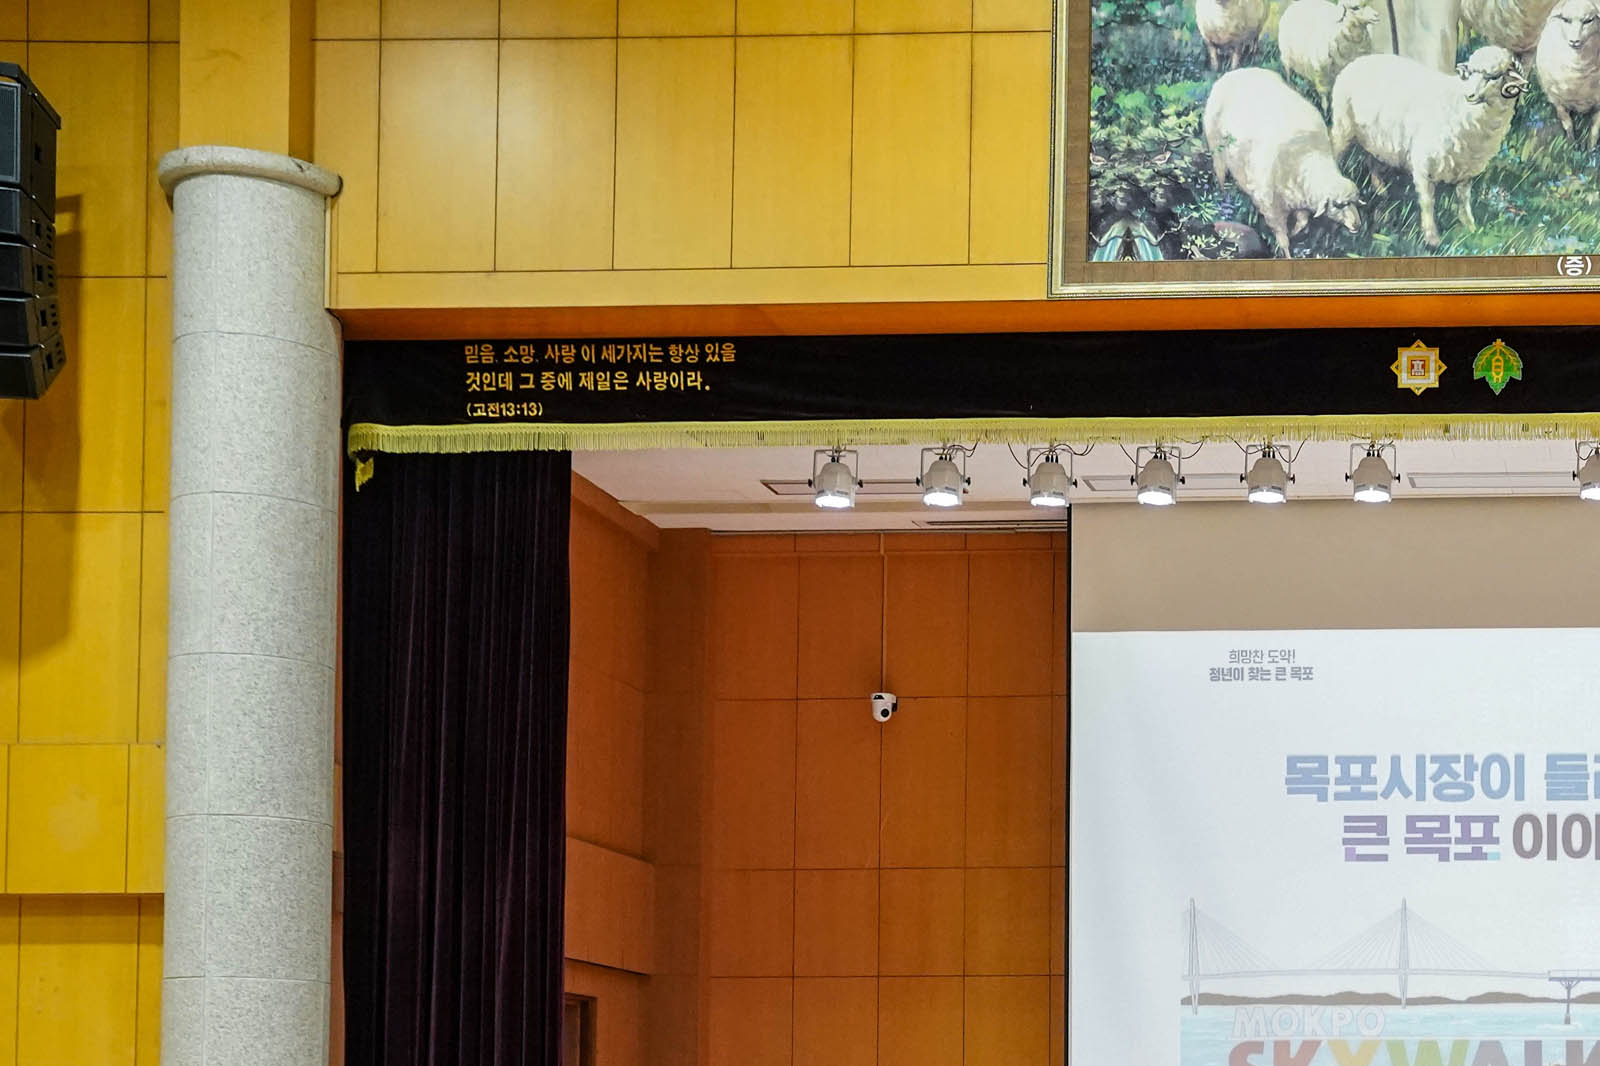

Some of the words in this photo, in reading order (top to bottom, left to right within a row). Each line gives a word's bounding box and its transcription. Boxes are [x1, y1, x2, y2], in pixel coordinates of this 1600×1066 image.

[1556, 255, 1591, 276] (증)
[544, 344, 576, 364] 사랑
[581, 344, 596, 364] 이
[601, 343, 664, 364] 세가지는
[669, 343, 700, 364] 항상
[705, 342, 737, 363] 있을
[465, 371, 513, 392] 것인데
[519, 374, 535, 390] 그
[540, 371, 572, 392] 중에
[578, 371, 629, 391] 제일은
[635, 370, 711, 391] 사랑이라.
[466, 402, 544, 417] (고전13:13)
[1228, 649, 1264, 664] 희망찬
[1267, 649, 1296, 664] 도약!
[1209, 667, 1245, 682] 청년이
[1247, 667, 1272, 682] 찾는
[1275, 667, 1287, 681] 큰
[1290, 666, 1314, 681] 목포
[1284, 753, 1526, 802] 목포시장이
[1341, 814, 1390, 863] 큰
[1403, 814, 1501, 863] 목포
[1232, 1006, 1387, 1038] MOKPO
